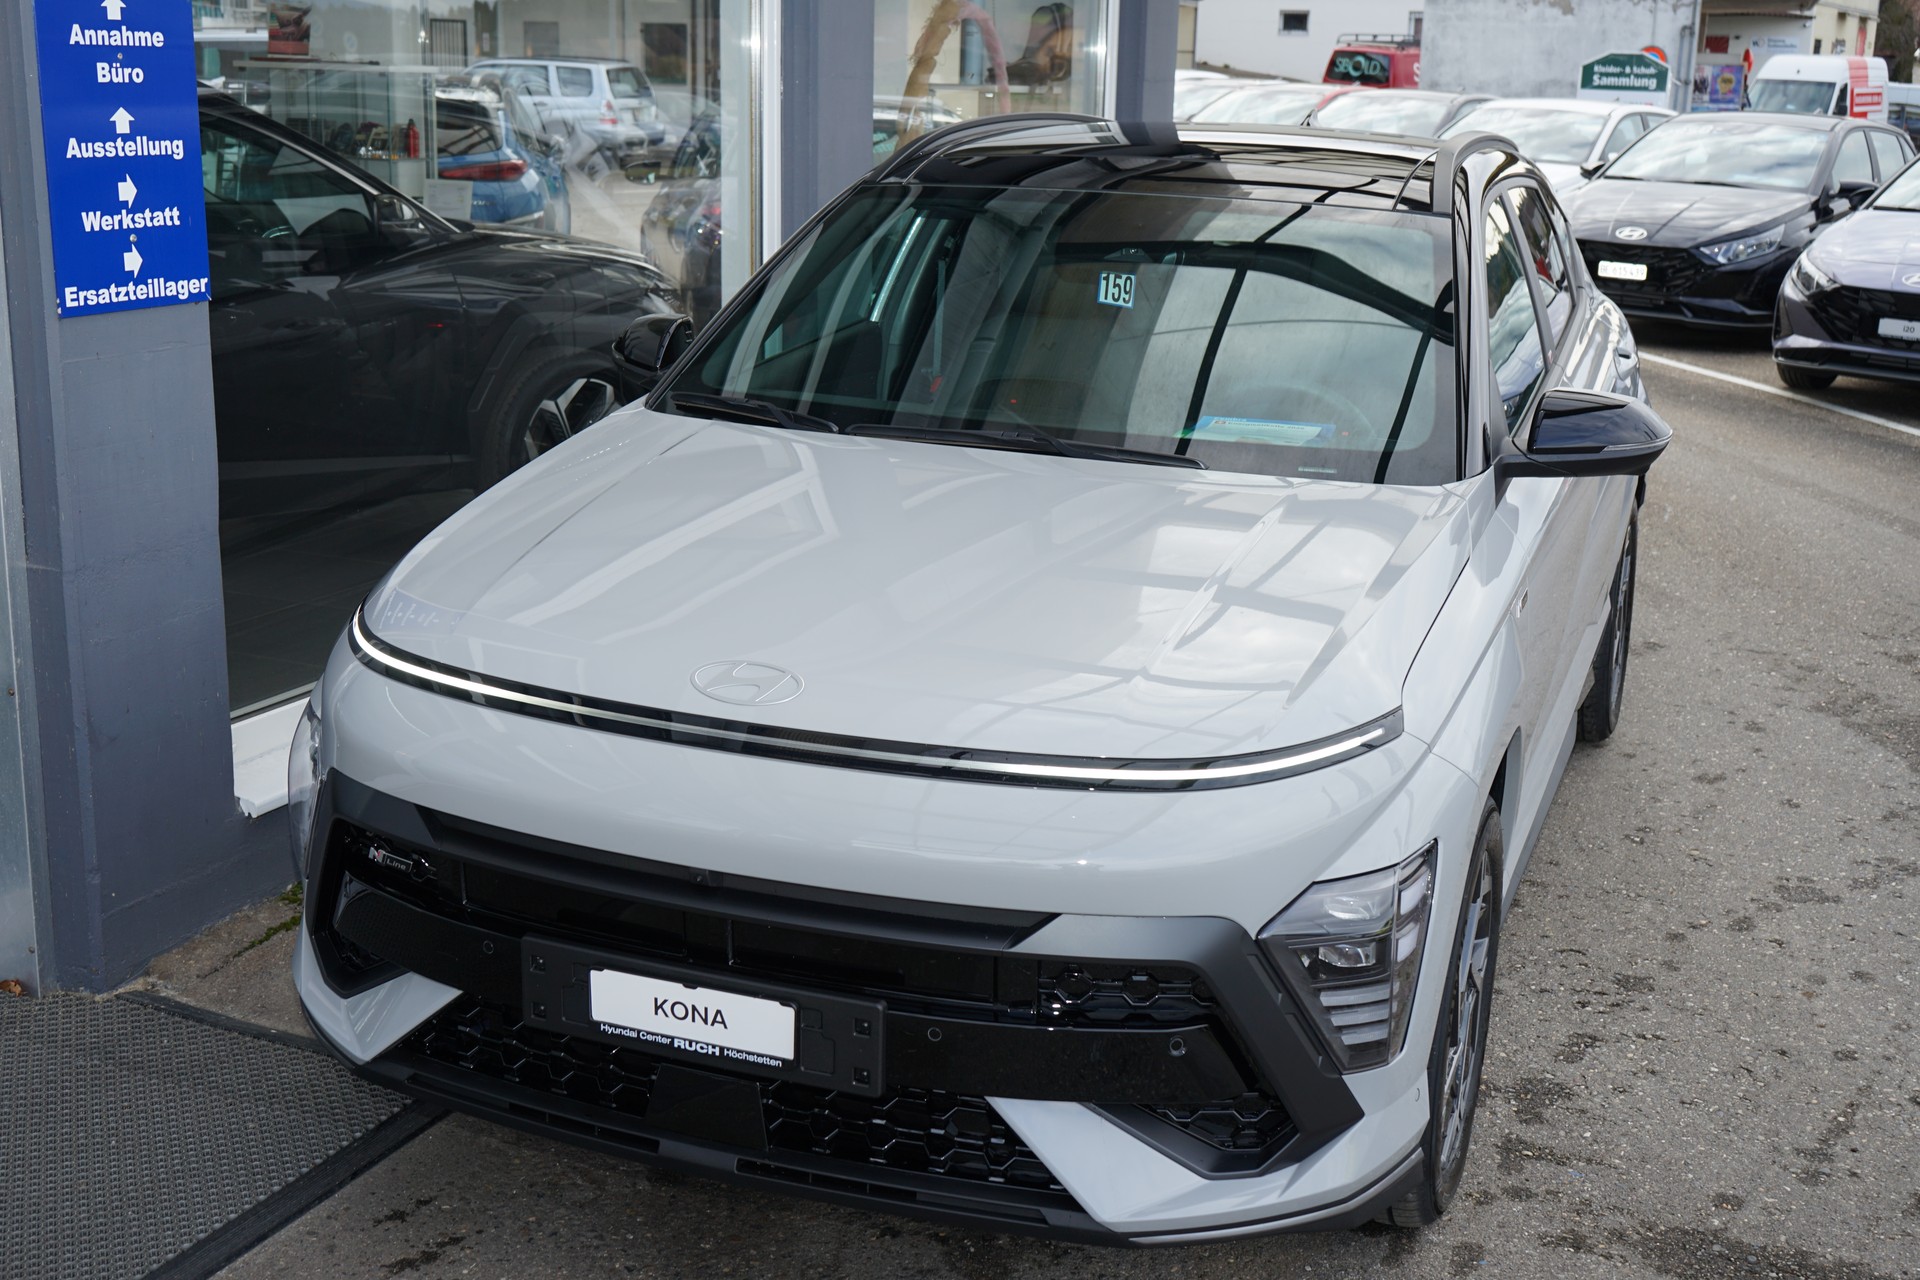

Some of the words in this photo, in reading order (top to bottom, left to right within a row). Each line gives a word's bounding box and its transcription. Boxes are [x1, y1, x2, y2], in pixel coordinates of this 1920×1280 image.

[69, 24, 164, 47] Annahme
[96, 61, 144, 83] Büro
[1592, 74, 1657, 90] Sammlung
[66, 136, 184, 160] Ausstellung
[81, 206, 180, 232] Werkstatt
[64, 277, 208, 308] Ersatzteillager
[1102, 273, 1133, 304] 159
[386, 858, 407, 870] Line
[654, 997, 728, 1029] KONA
[600, 1023, 638, 1038] Hyundai
[640, 1031, 671, 1045] Center
[674, 1038, 720, 1056] RUCH
[724, 1048, 782, 1068] Höchstetten
